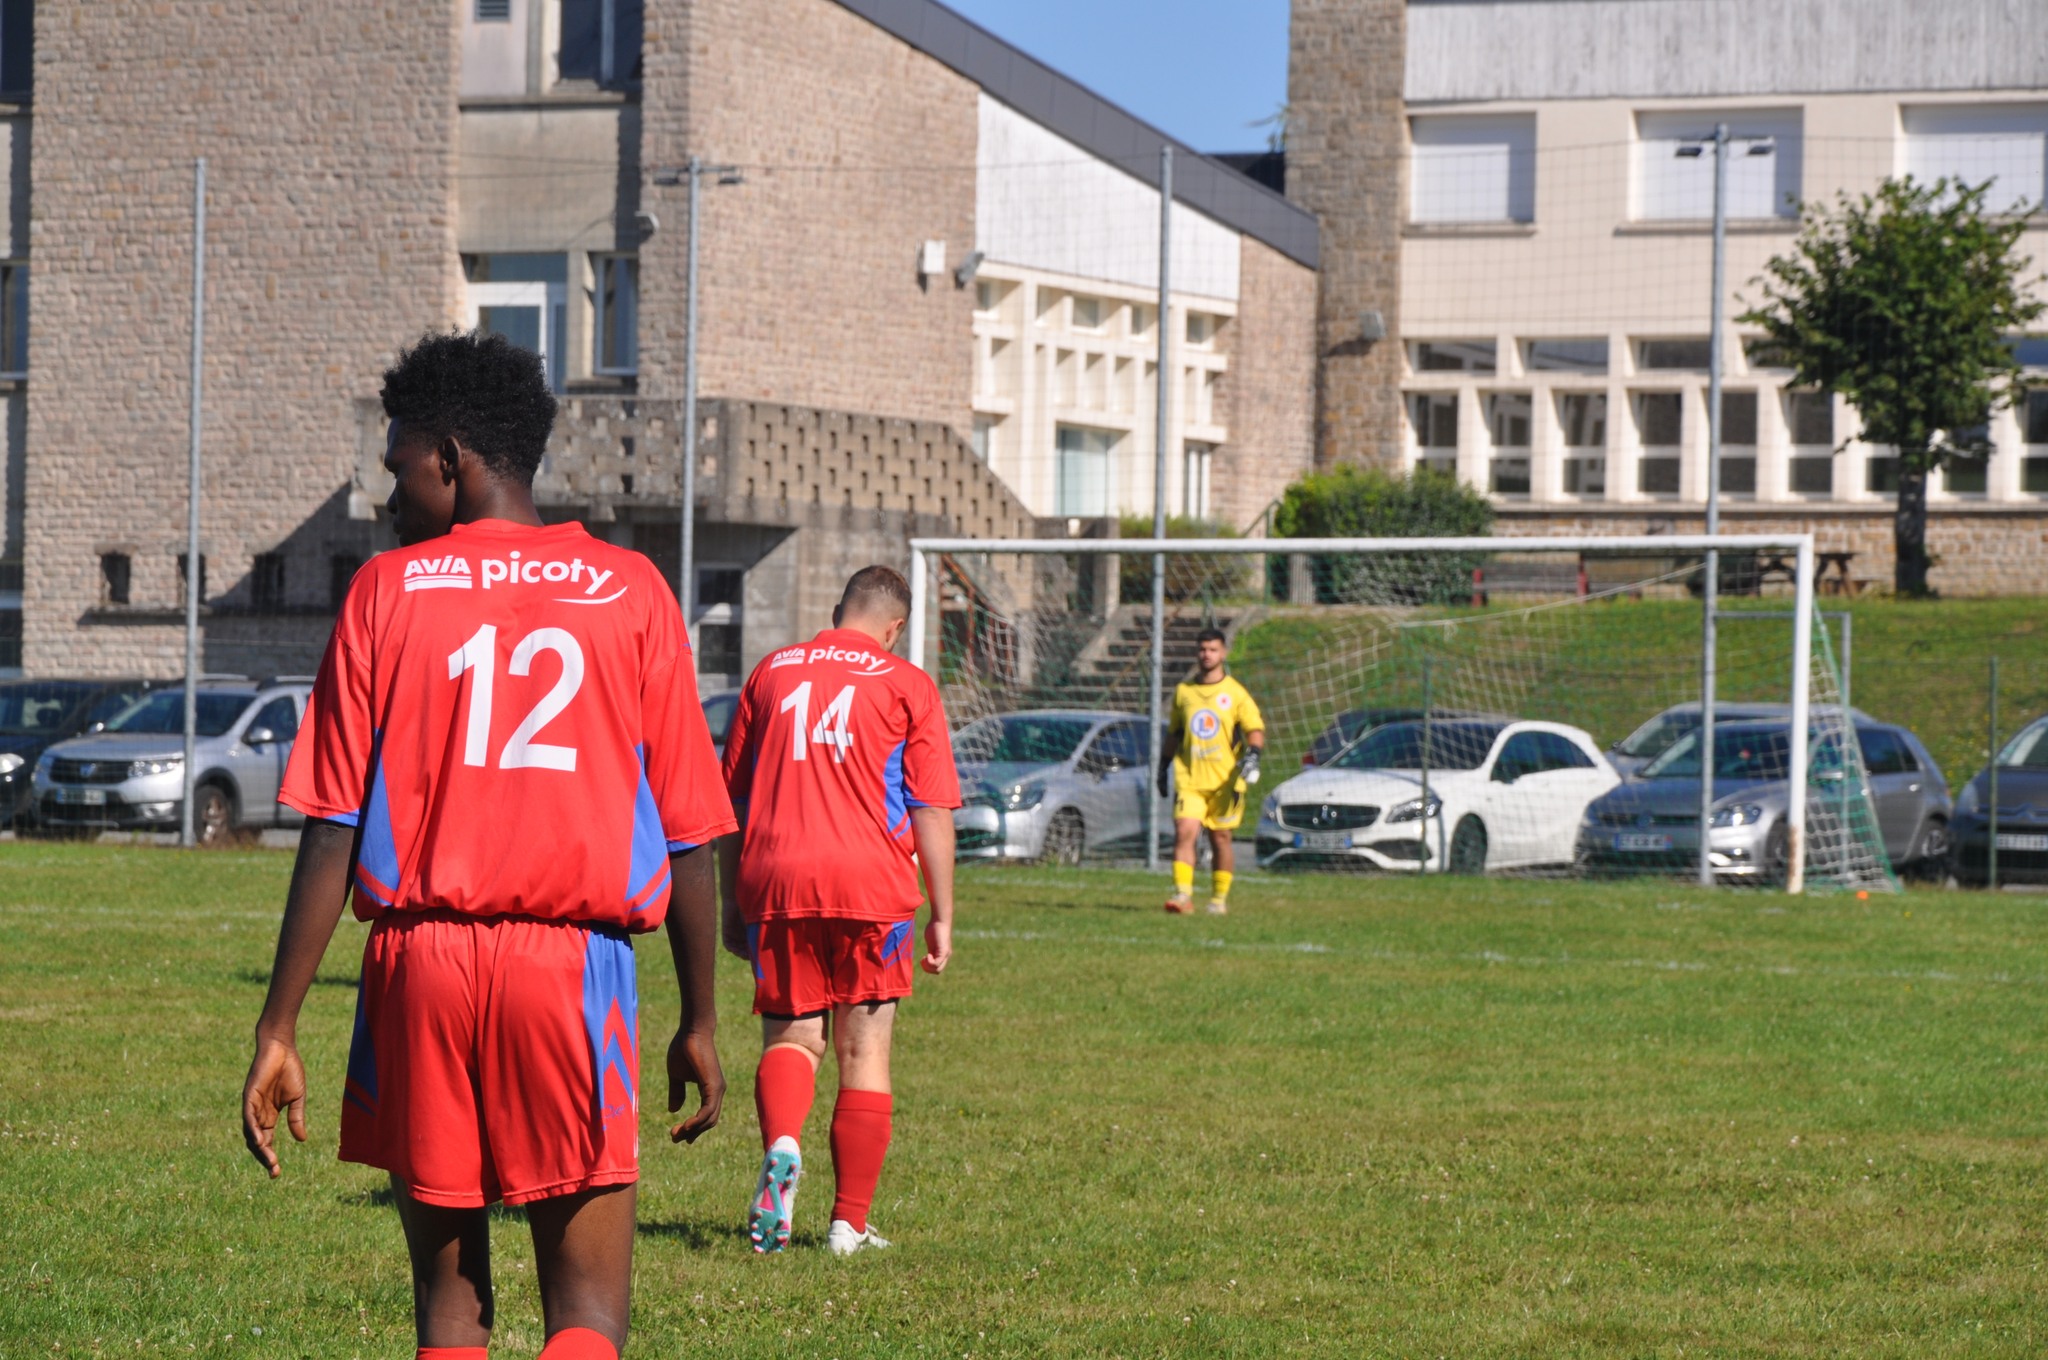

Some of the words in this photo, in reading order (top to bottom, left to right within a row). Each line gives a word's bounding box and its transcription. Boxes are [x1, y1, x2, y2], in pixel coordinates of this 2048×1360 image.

[482, 551, 614, 595] picoty
[808, 645, 886, 671] picoty
[447, 623, 585, 772] 12
[780, 681, 856, 763] 14
